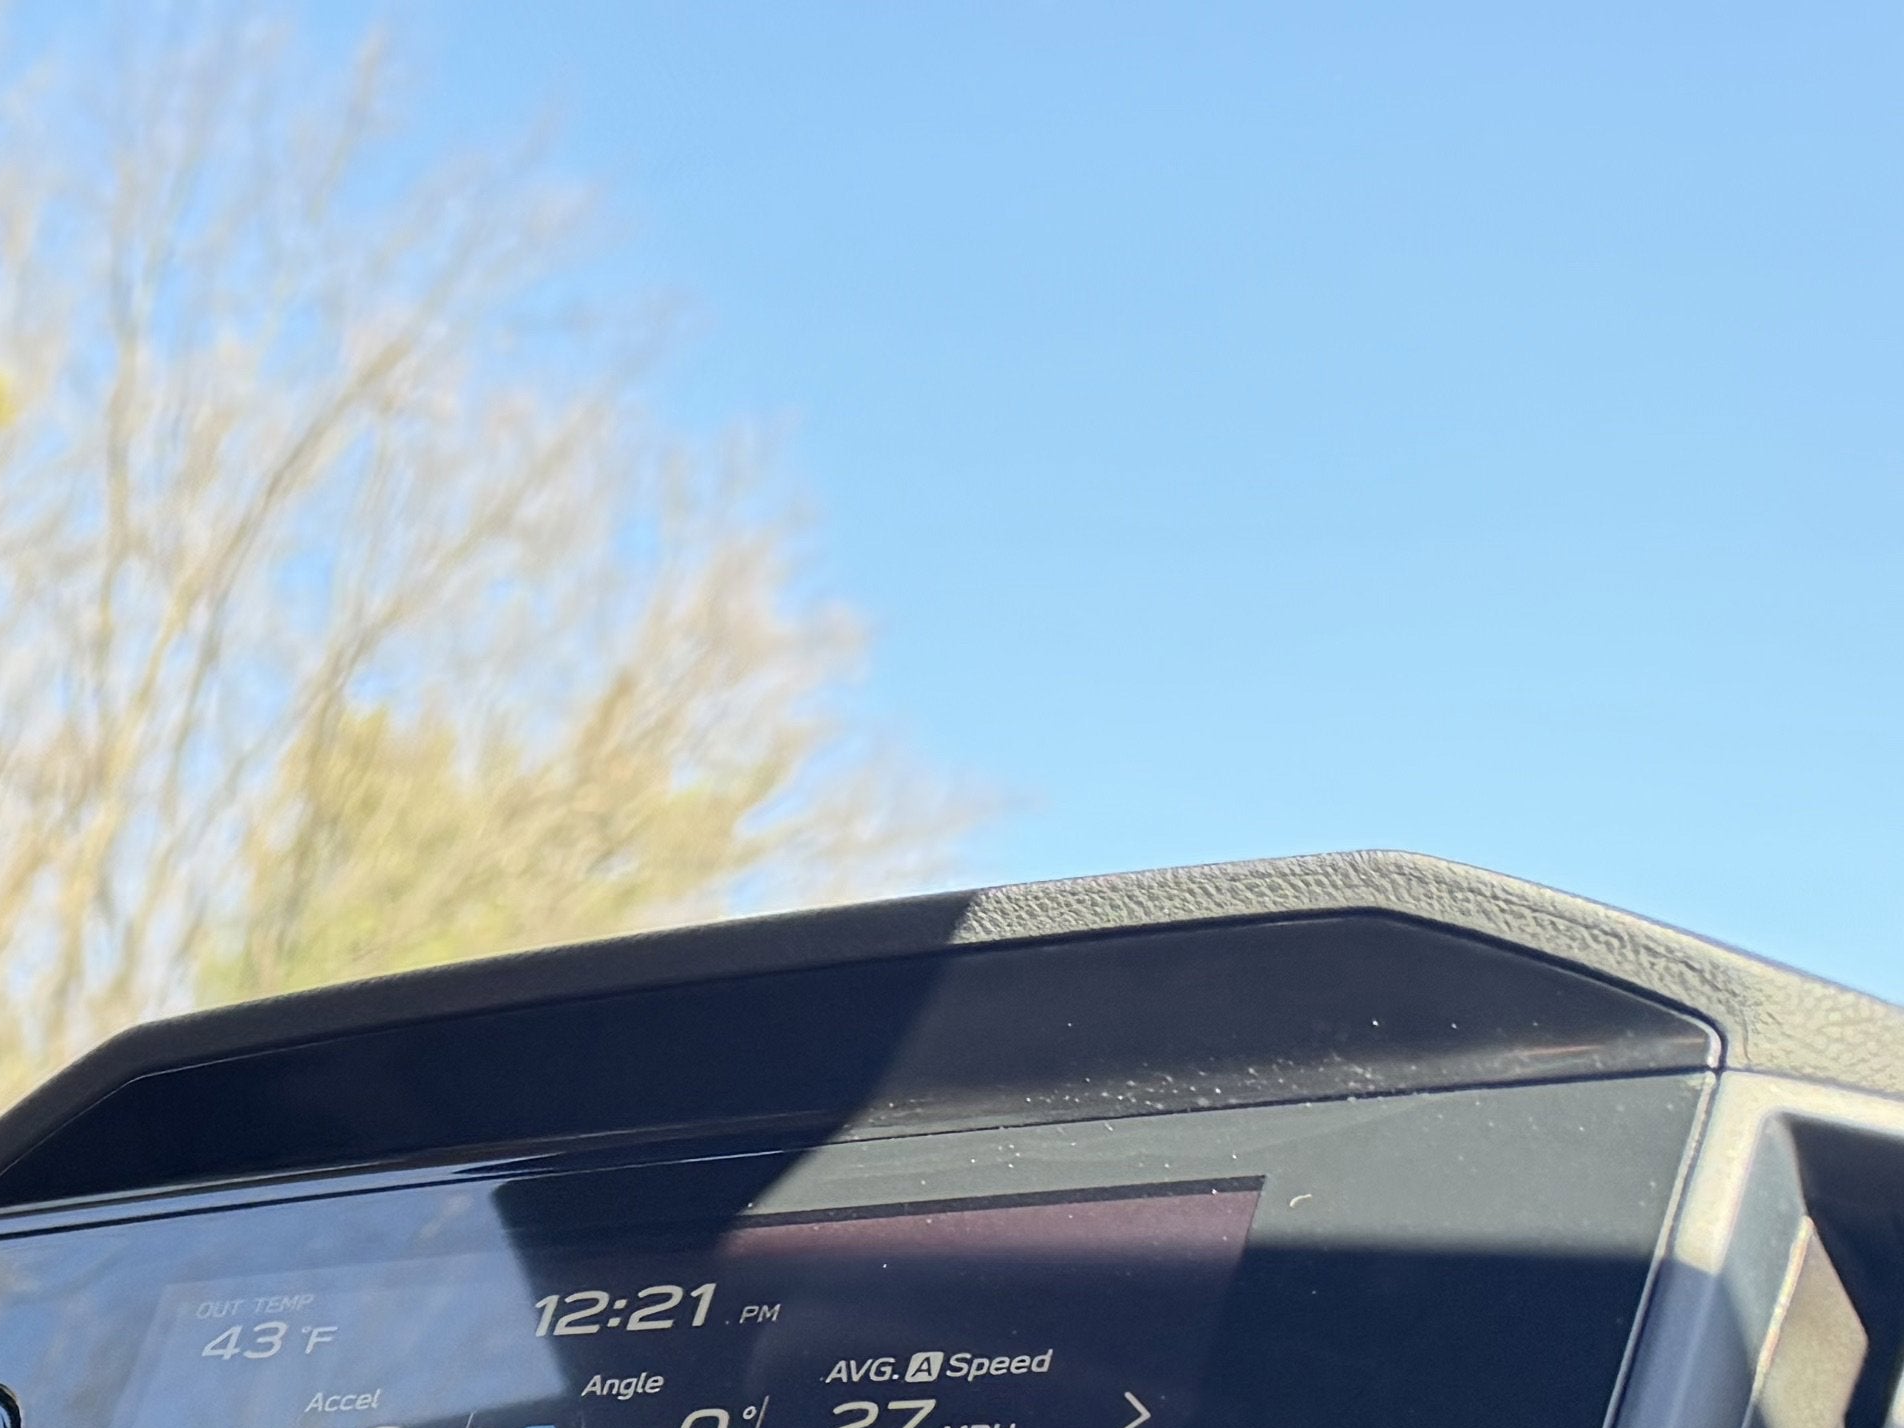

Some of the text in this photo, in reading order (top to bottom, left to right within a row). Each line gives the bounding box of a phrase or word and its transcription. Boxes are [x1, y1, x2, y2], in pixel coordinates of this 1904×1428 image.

[196, 1293, 316, 1321] OUT TEMP
[535, 1282, 781, 1337] 12:21 PM
[825, 1357, 899, 1384] AVG.
[945, 1349, 1055, 1379] Speed
[304, 1388, 382, 1414] Accel
[581, 1371, 665, 1401] Angle
